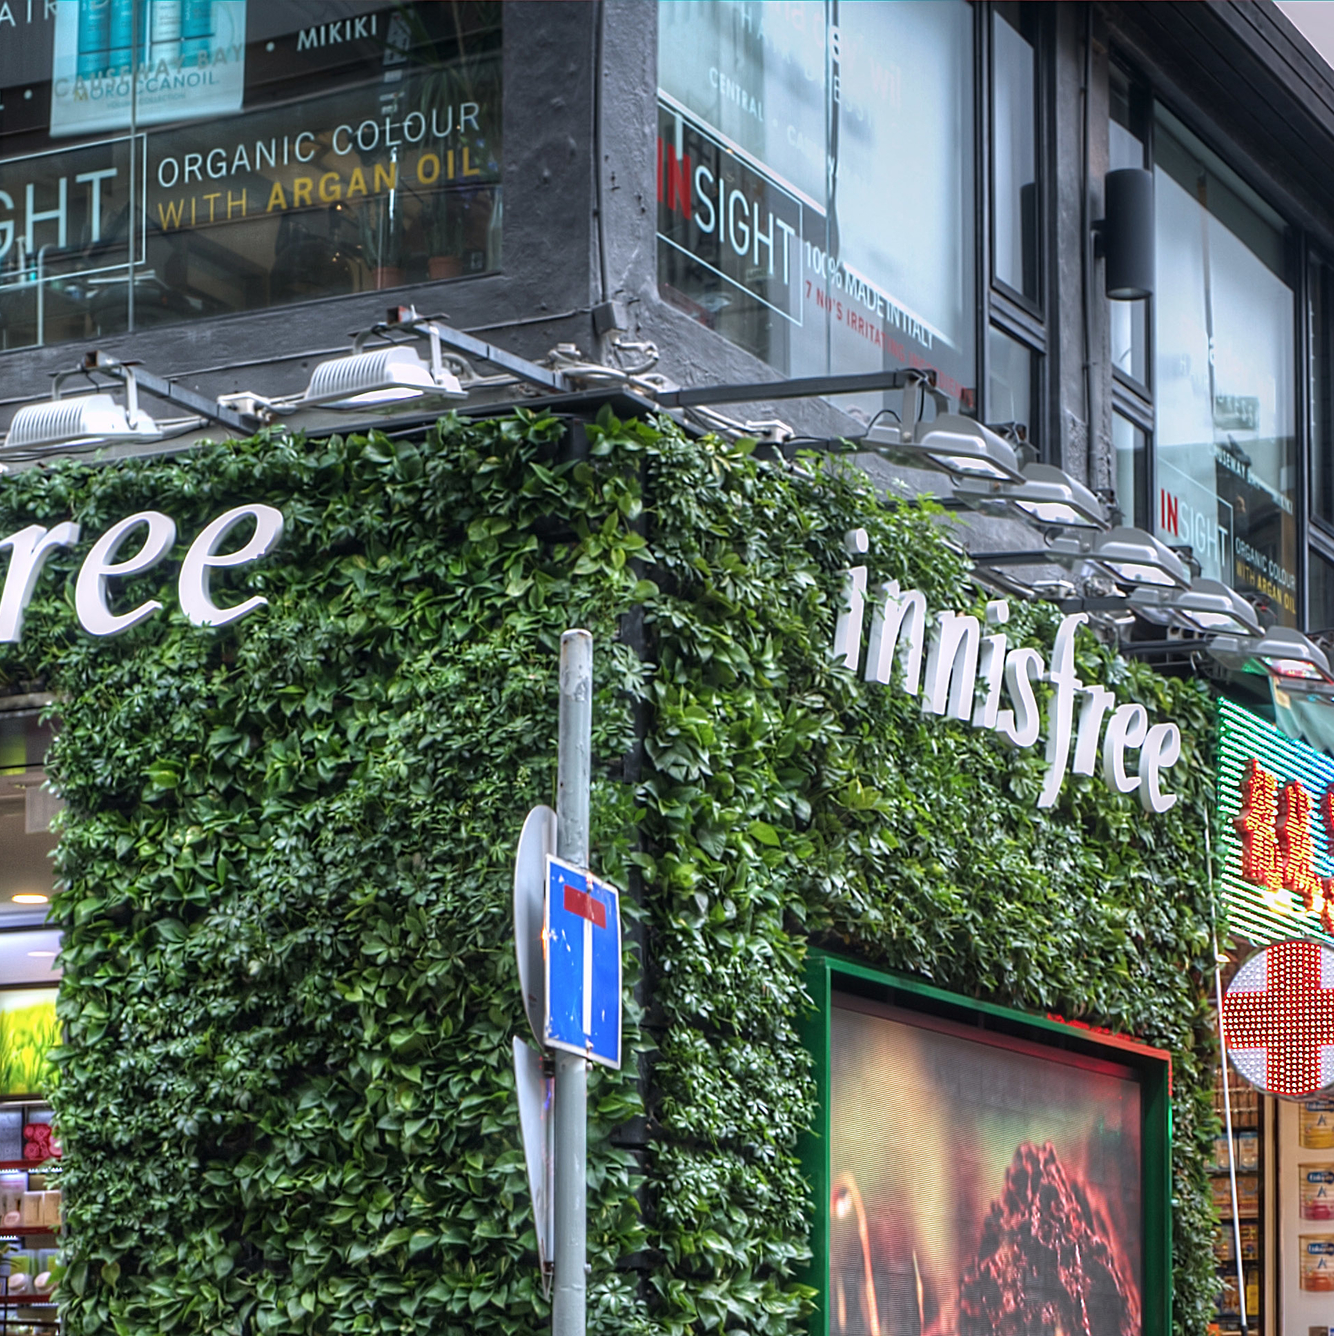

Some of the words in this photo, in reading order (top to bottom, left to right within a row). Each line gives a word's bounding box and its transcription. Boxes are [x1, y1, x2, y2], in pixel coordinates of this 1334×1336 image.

[296, 15, 378, 52] MIKIKI
[54, 54, 186, 98] CAUSEWAY
[197, 43, 244, 71] BAY
[708, 66, 764, 122] CENTRAL
[157, 132, 315, 189] ORGANIC
[332, 102, 481, 156] COLOUR
[157, 188, 248, 231] WITH
[267, 161, 397, 213] ARGAN
[417, 147, 481, 186] OIL
[657, 135, 796, 286] INSIGHT
[804, 240, 843, 290] 100%
[844, 266, 885, 320] MADE
[886, 297, 901, 331] IN
[846, 308, 906, 363] IRRITATING
[1161, 488, 1228, 568] INSIGHT
[1235, 536, 1267, 574] ORGANIC
[1268, 559, 1296, 591] COLOUR
[1235, 559, 1255, 585] WITH
[1257, 574, 1282, 604] ARGAN
[1284, 594, 1296, 614] OIL
[833, 528, 1181, 813] innisfree
